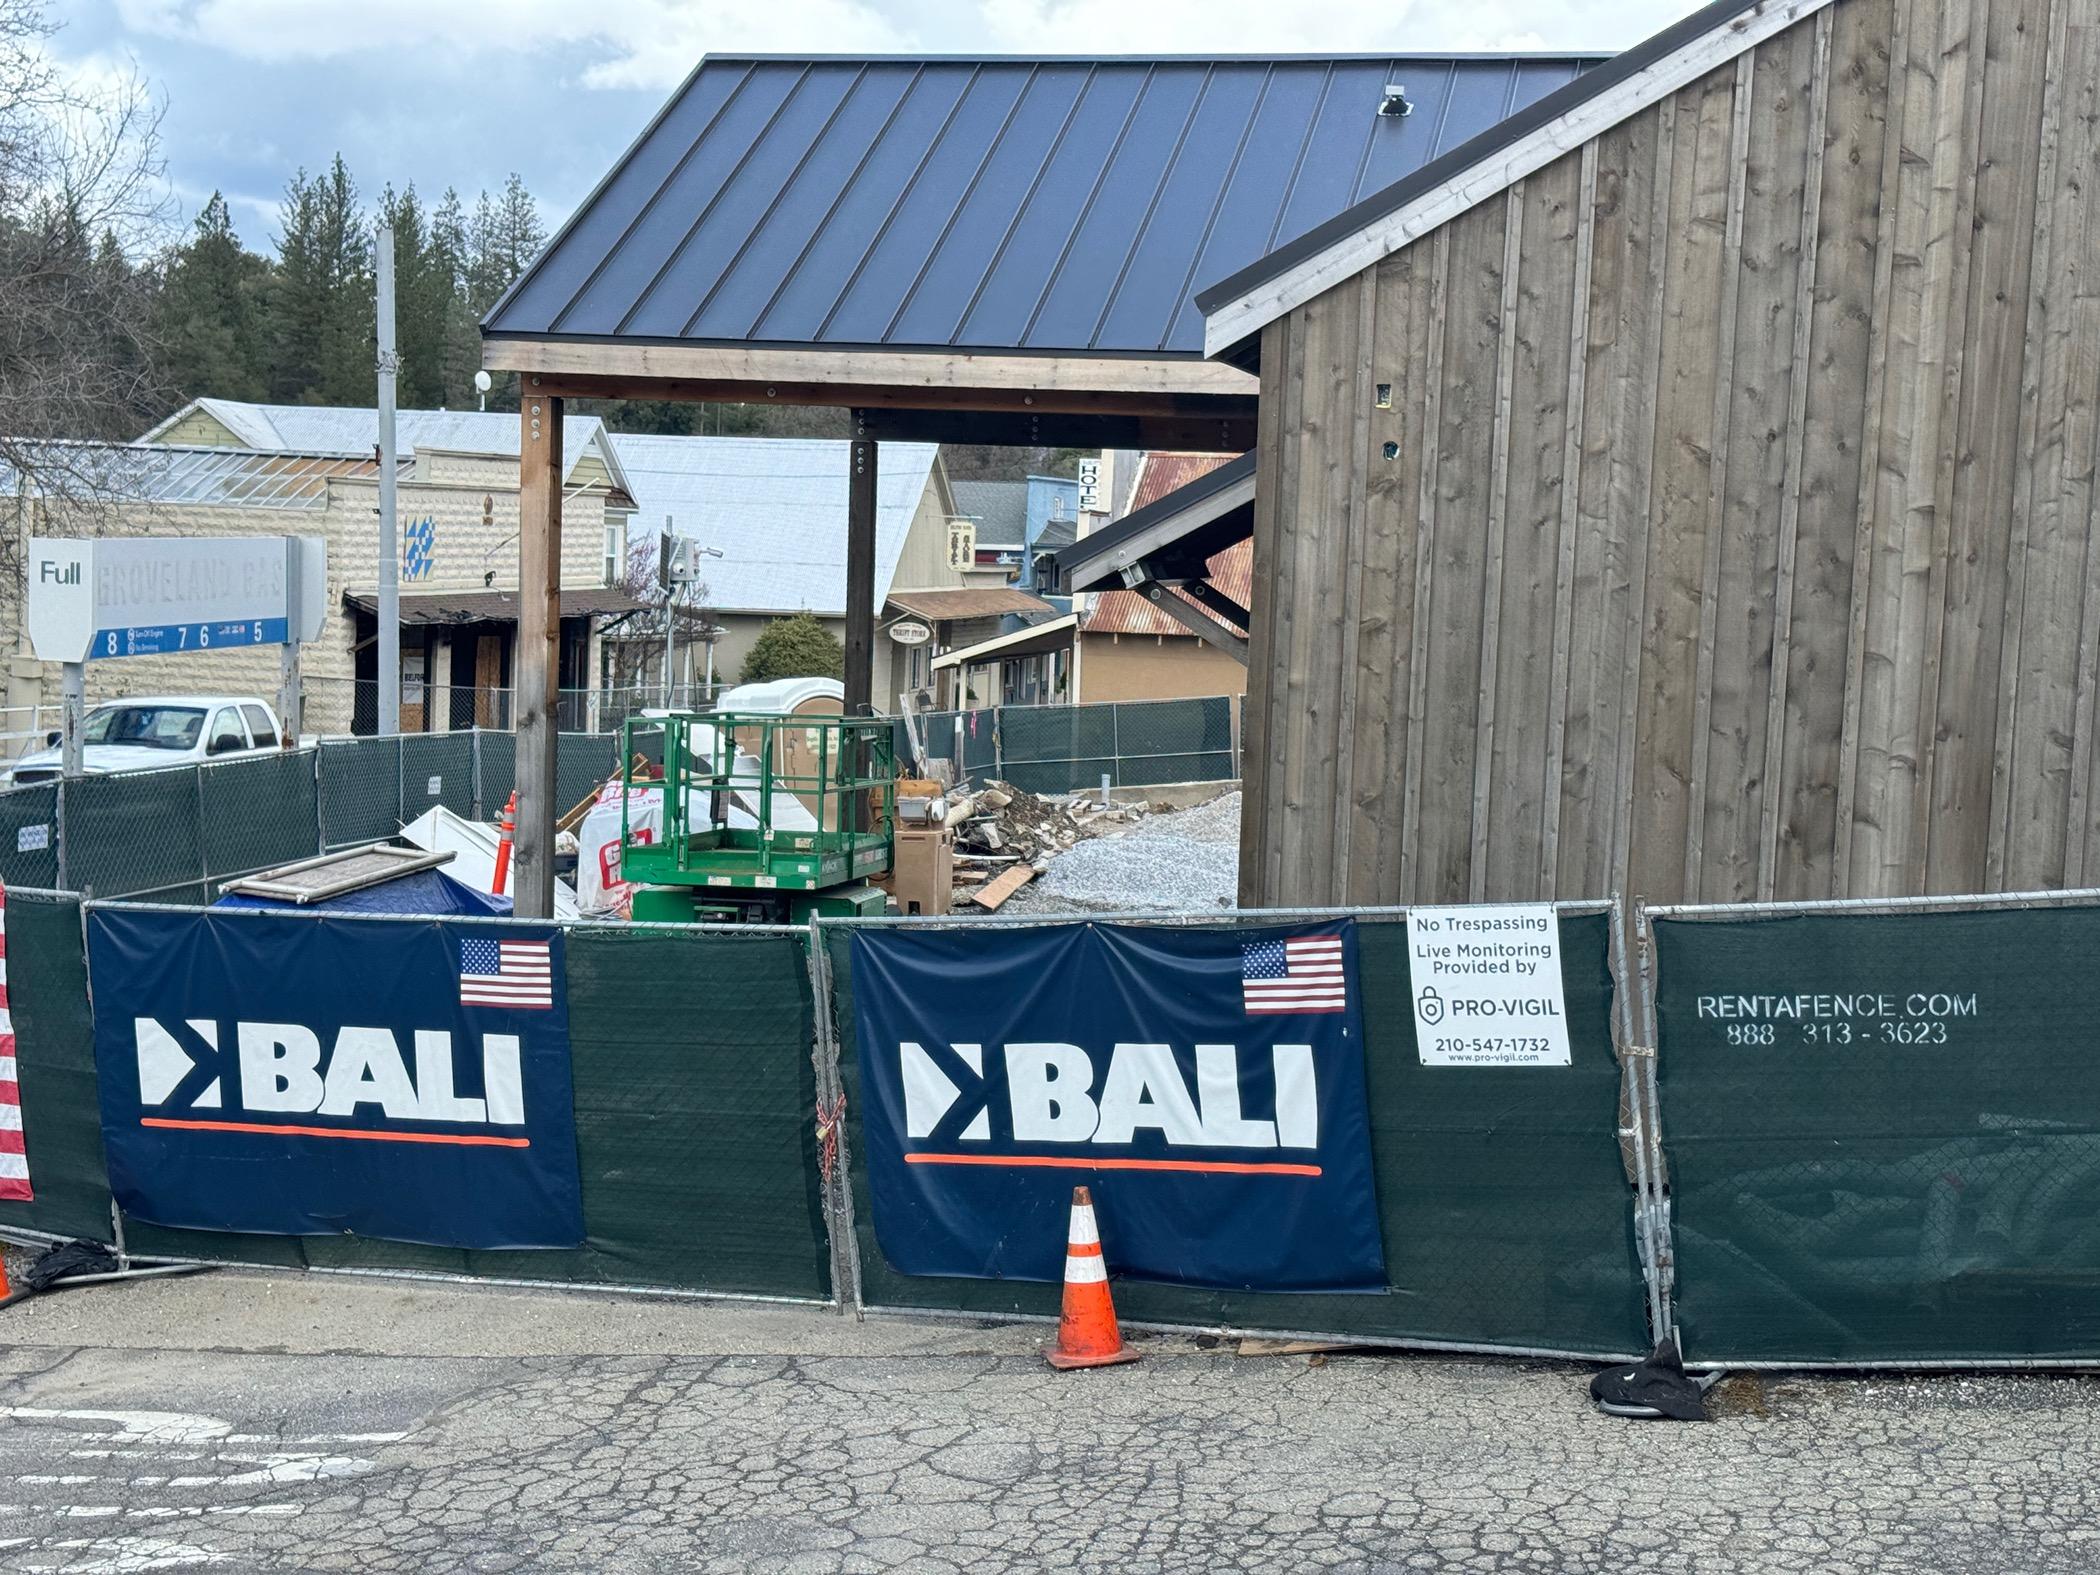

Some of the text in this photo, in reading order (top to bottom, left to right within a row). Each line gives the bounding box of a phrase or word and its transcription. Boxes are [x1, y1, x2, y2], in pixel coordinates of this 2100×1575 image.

[1080, 465, 1097, 508] HOTE
[40, 560, 81, 585] Full
[107, 632, 118, 655] 8
[178, 627, 187, 649] 7
[200, 625, 209, 647] 6
[254, 622, 263, 642] 5
[1417, 915, 1548, 933] No Trespassing
[1417, 942, 1551, 959] Live Monitoring
[1433, 959, 1537, 976] Provided by
[1452, 999, 1560, 1016] PRO-VIGIL
[1697, 993, 1977, 1019] RENTAFENCE.COM
[1435, 1038, 1551, 1052] 210-547-1732
[1727, 1023, 1776, 1046] 888
[1802, 1022, 1852, 1045] 313
[1880, 1022, 1947, 1045] 3623
[1448, 1052, 1539, 1063] www.pro-vigil.com
[237, 1021, 525, 1125] BALI
[1004, 1042, 1318, 1148] BALI
